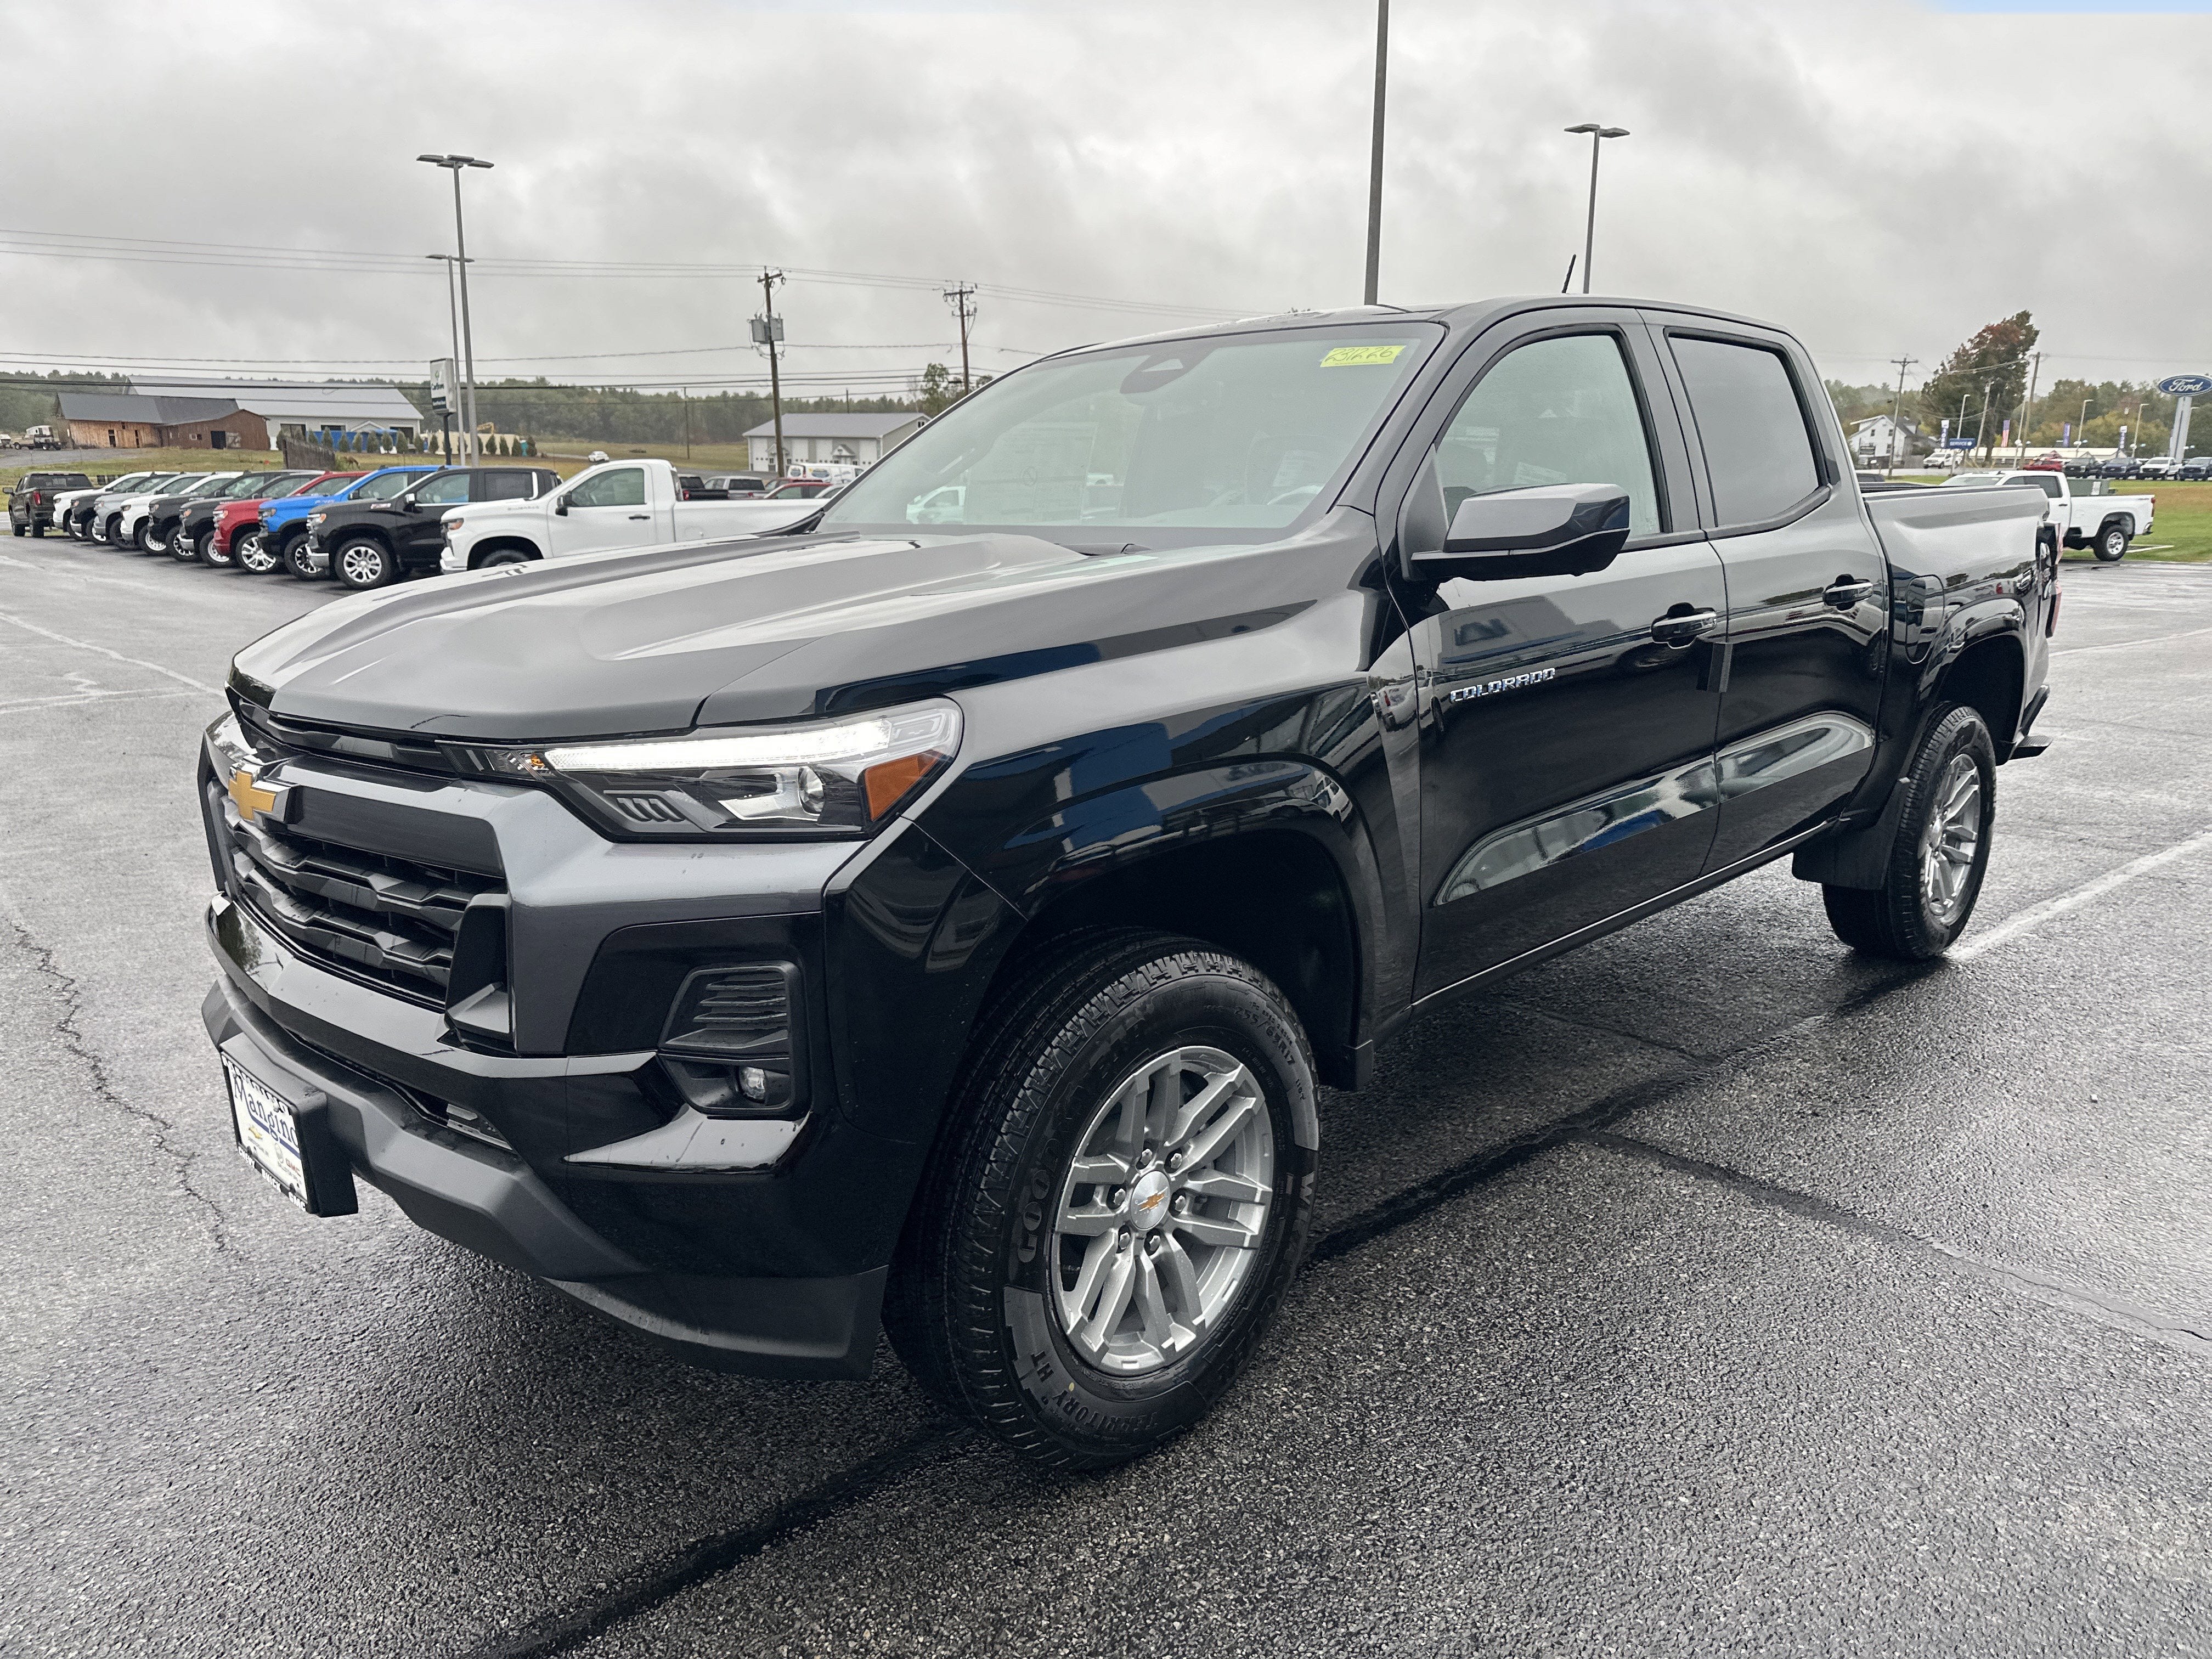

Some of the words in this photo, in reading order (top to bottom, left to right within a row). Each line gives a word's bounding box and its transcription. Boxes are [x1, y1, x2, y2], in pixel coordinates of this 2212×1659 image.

[2169, 379, 2204, 392] Ford
[1450, 667, 1556, 702] COLORADO
[261, 1169, 281, 1193] BUICK
[289, 1192, 306, 1212] GMC
[1031, 1351, 1054, 1383] HT
